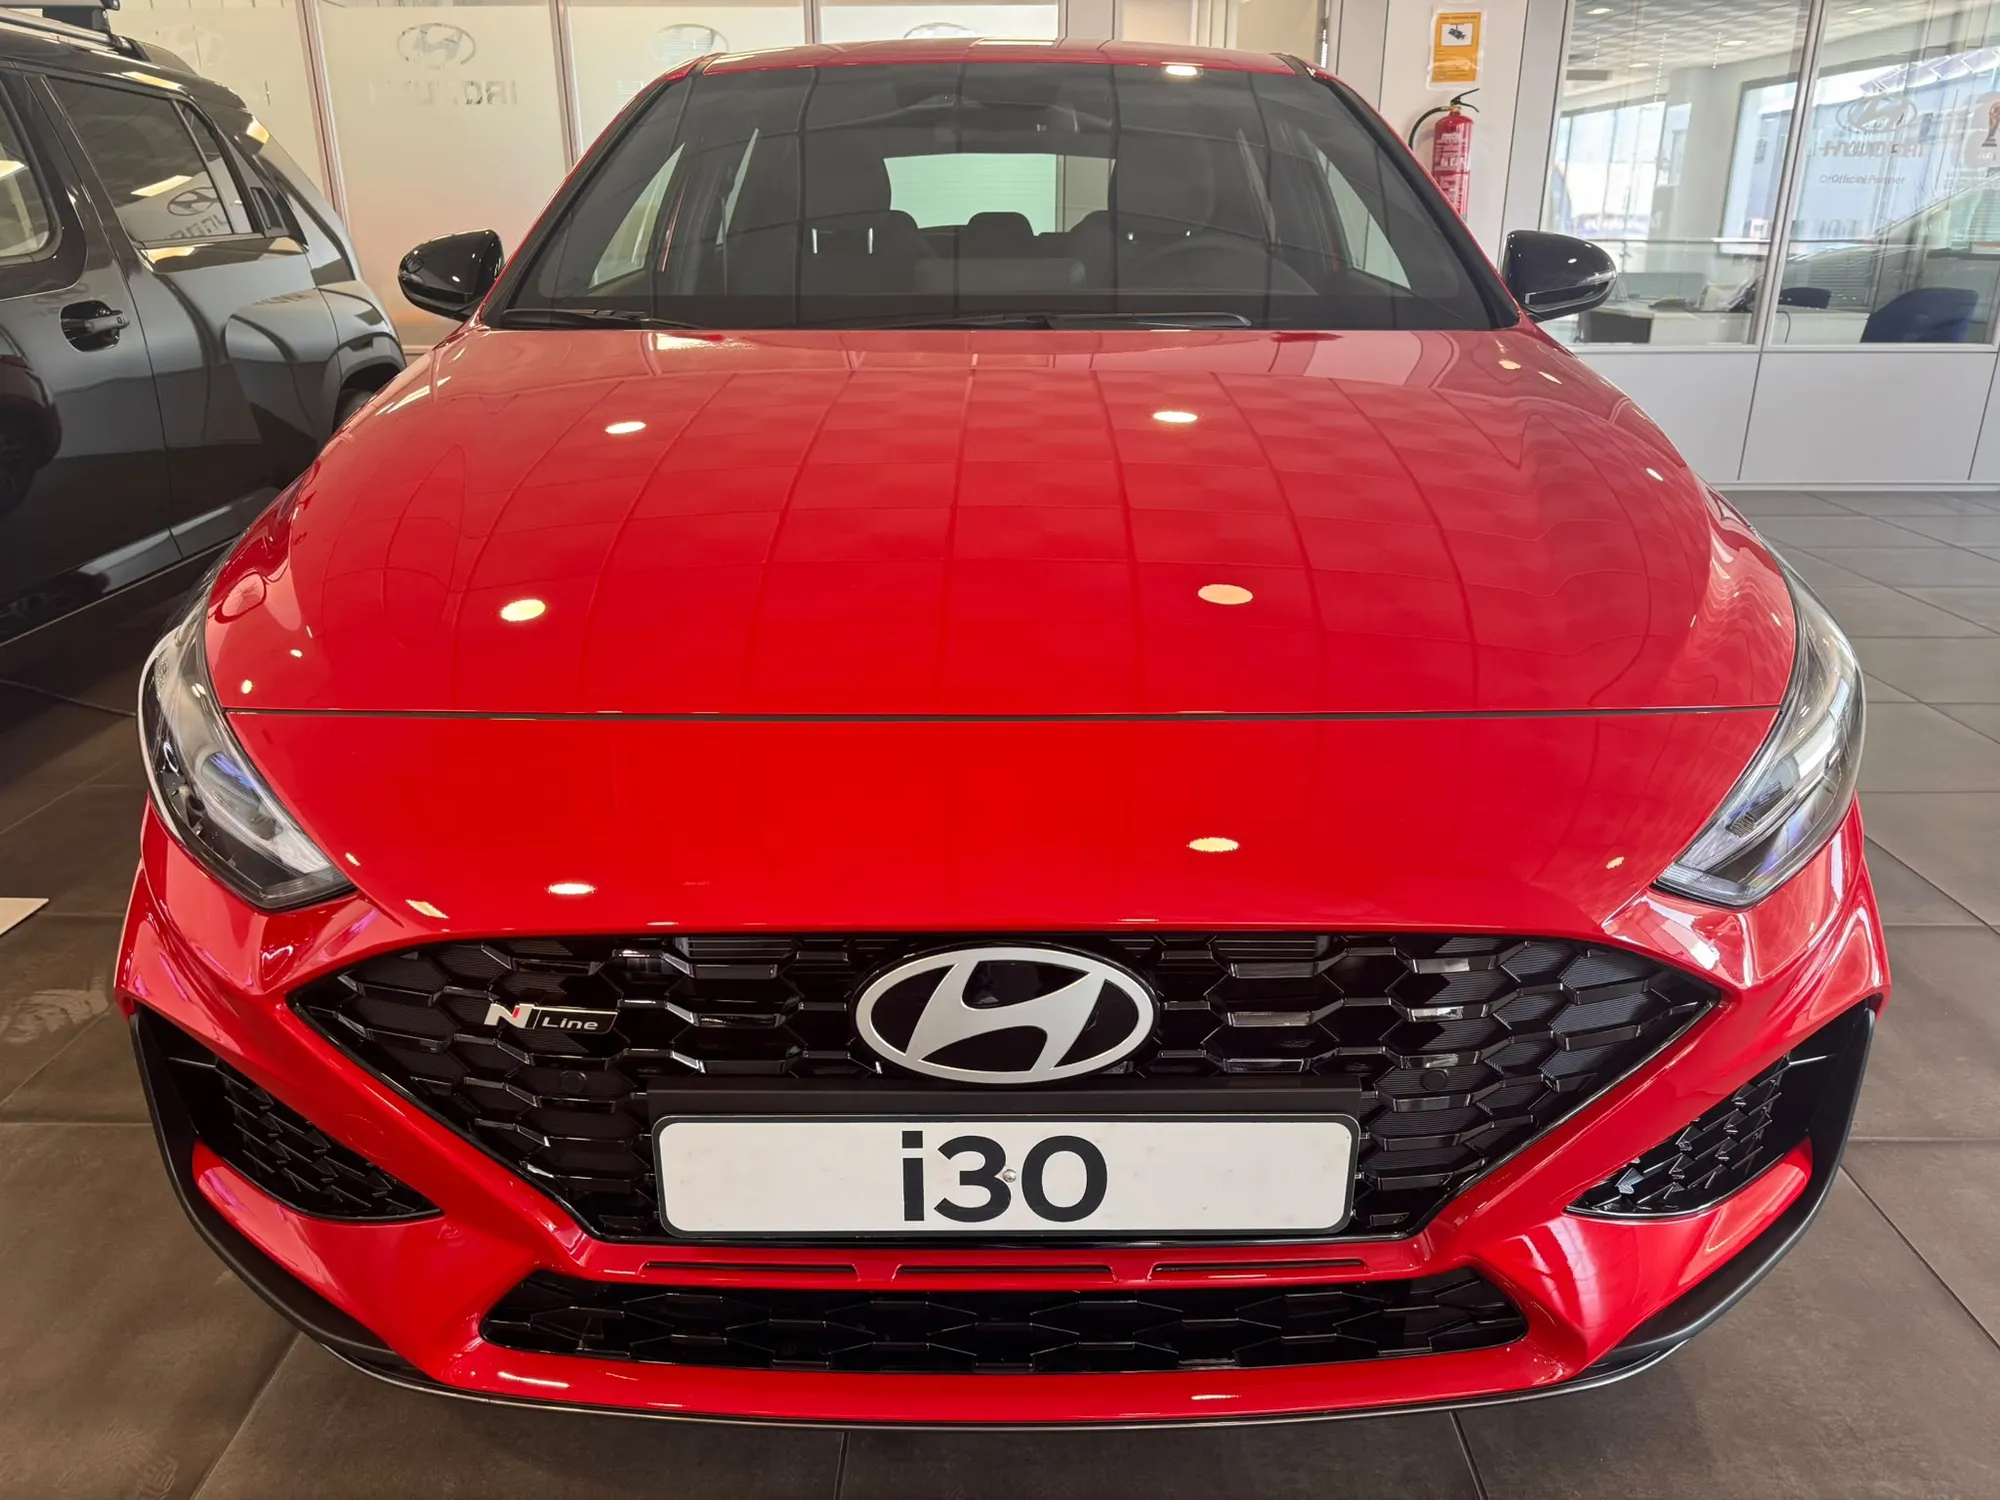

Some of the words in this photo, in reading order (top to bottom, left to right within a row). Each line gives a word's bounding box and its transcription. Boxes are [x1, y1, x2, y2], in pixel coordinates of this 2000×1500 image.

[484, 1003, 535, 1028] N
[542, 1017, 599, 1030] Line
[902, 1131, 1108, 1223] i30
